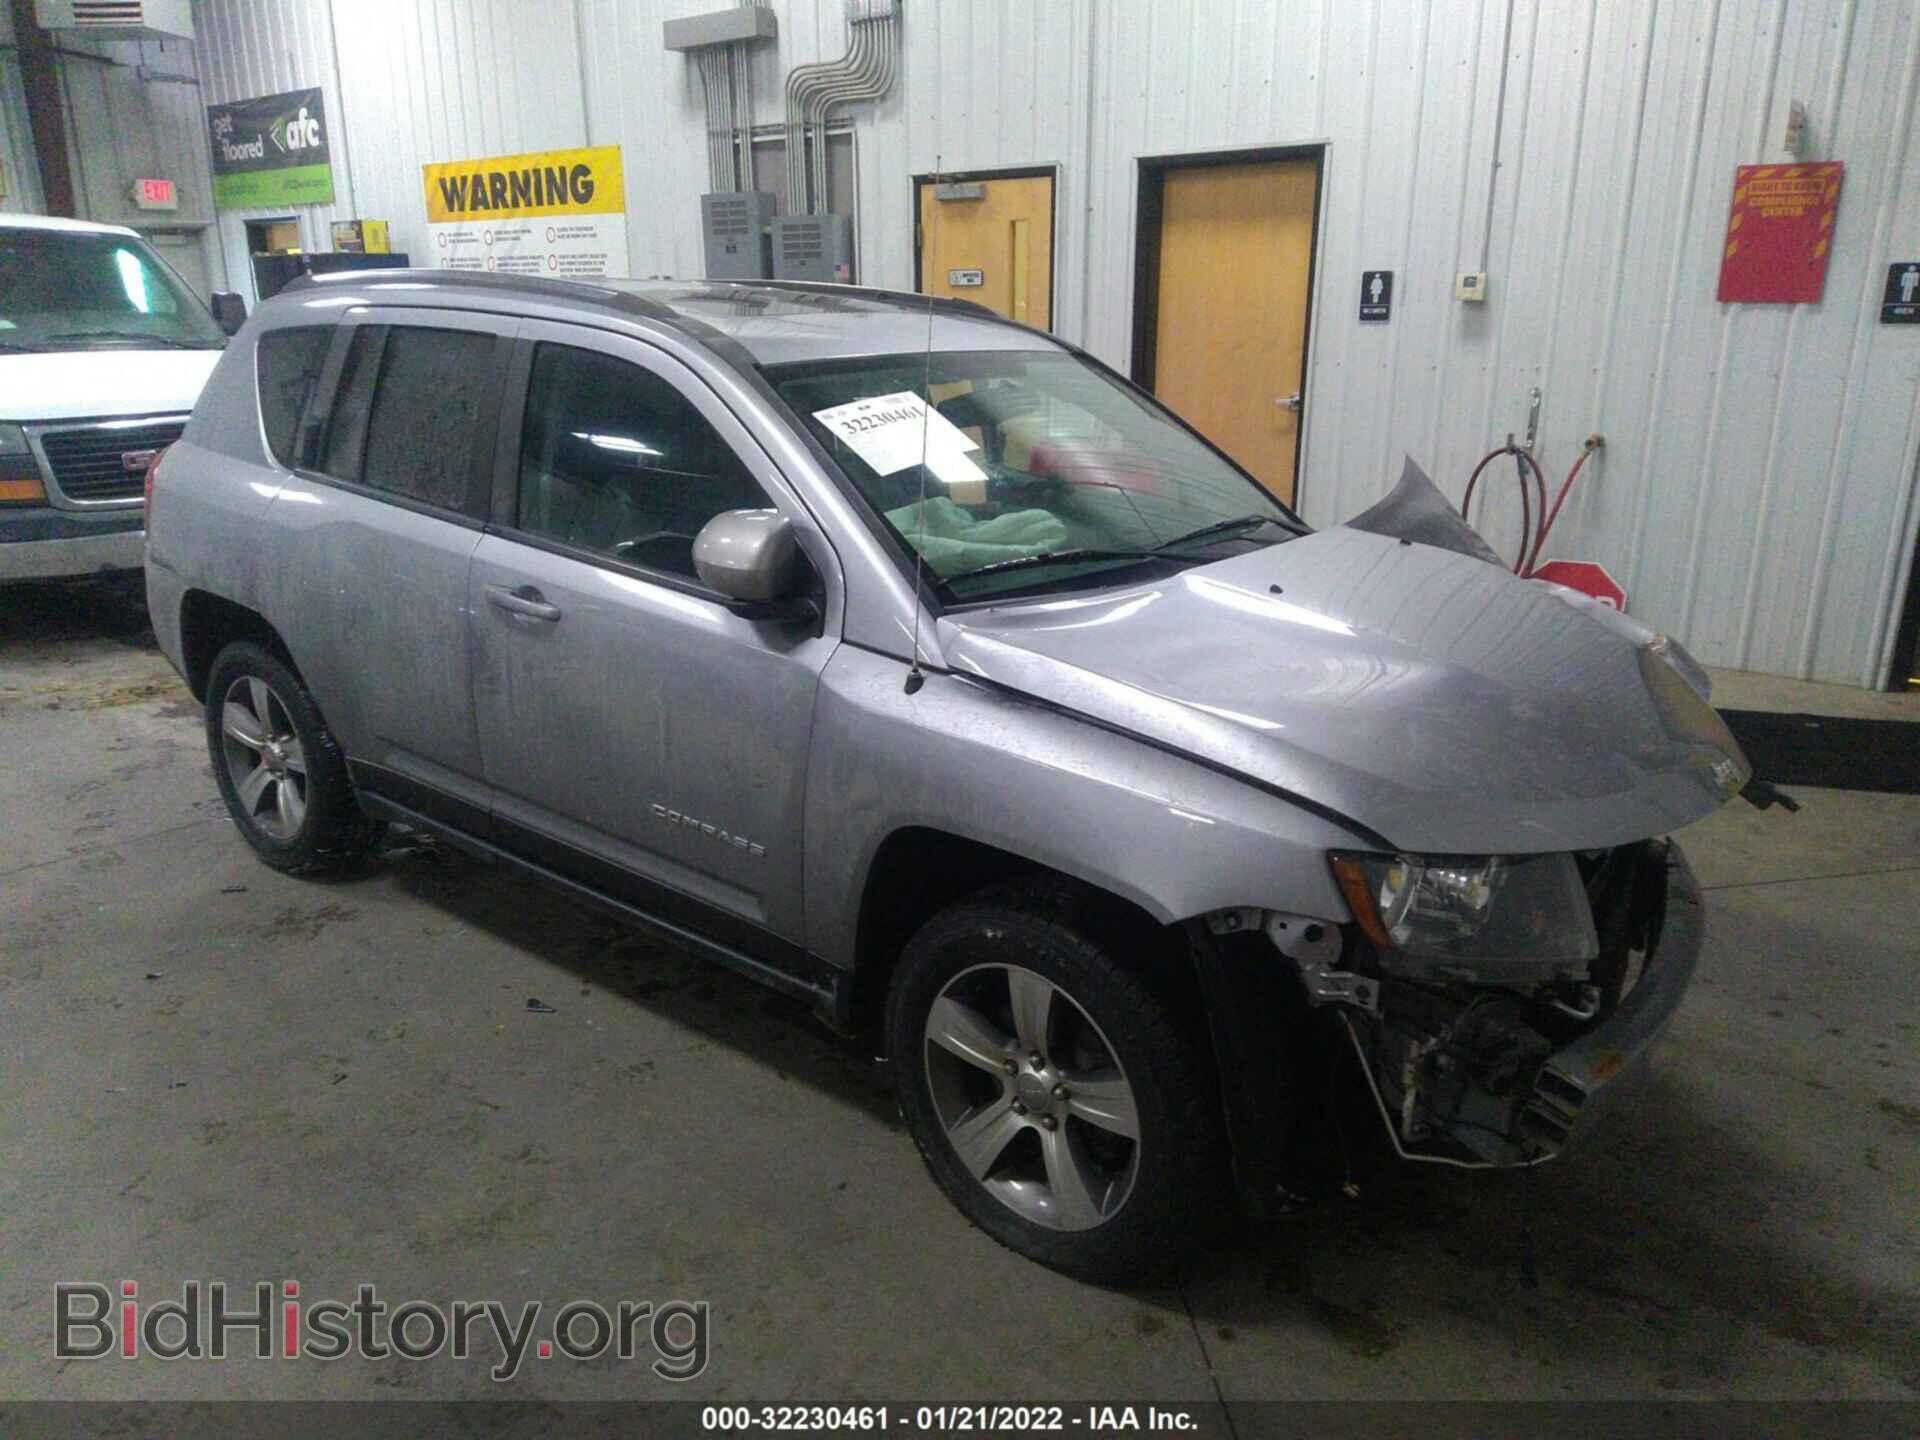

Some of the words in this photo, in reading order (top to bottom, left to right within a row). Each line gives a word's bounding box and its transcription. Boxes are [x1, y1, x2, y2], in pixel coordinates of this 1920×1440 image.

[213, 113, 234, 140] get
[286, 107, 320, 150] afc
[222, 133, 264, 161] floored
[144, 181, 170, 201] EXIT
[438, 163, 594, 213] WARNING
[840, 405, 924, 434] 32230461
